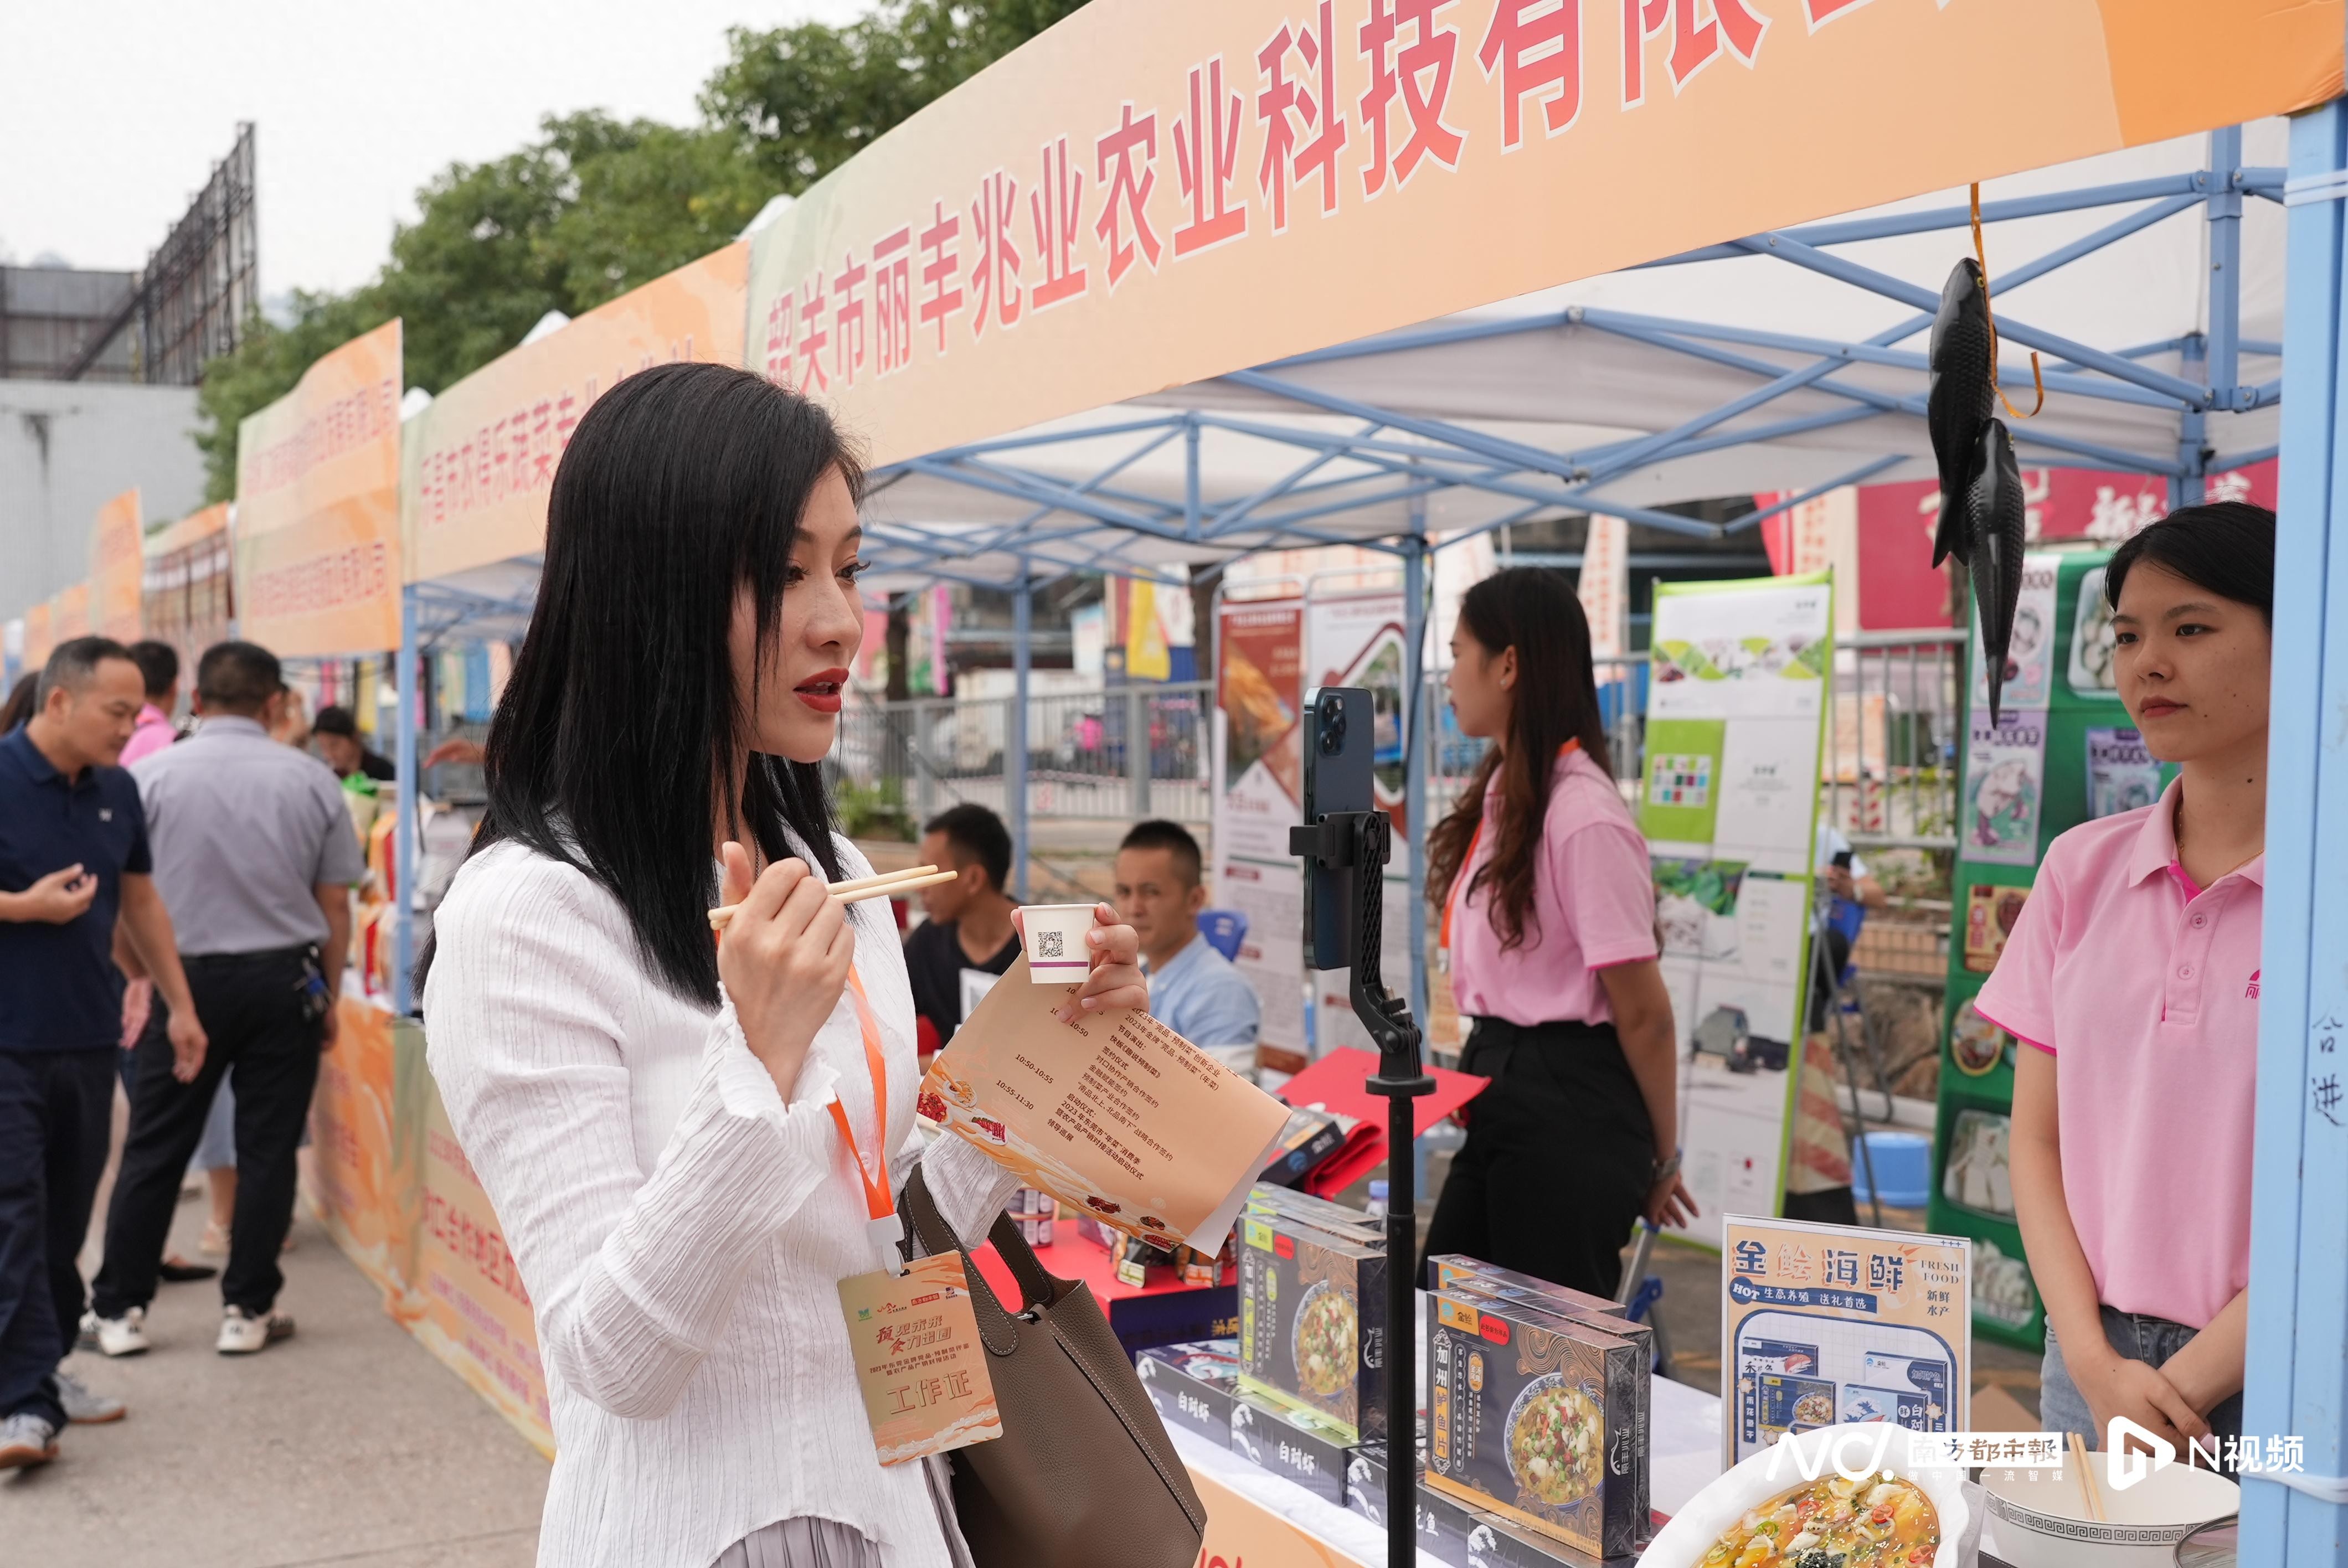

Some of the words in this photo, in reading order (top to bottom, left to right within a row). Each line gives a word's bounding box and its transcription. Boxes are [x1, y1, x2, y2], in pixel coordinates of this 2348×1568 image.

[1015, 1054, 1054, 1084] 10:50-10:55
[1101, 1046, 1129, 1070] 签约仪式
[996, 1080, 1034, 1110] 10:55-11:30
[1081, 1072, 1141, 1120] 预制菜产业合作签约
[1061, 1100, 1078, 1116] 2023
[1047, 1118, 1074, 1142] 领导巡展
[1920, 1259, 1959, 1272] FRESH
[1924, 1272, 1959, 1285] FOOD
[1732, 1283, 1760, 1301] HOT
[1764, 1287, 1810, 1303] 生态养殖
[1820, 1293, 1867, 1310] 送礼首选
[1927, 1289, 1950, 1303] 新鲜
[1927, 1306, 1950, 1317] 水产
[886, 1370, 973, 1415] 工作证
